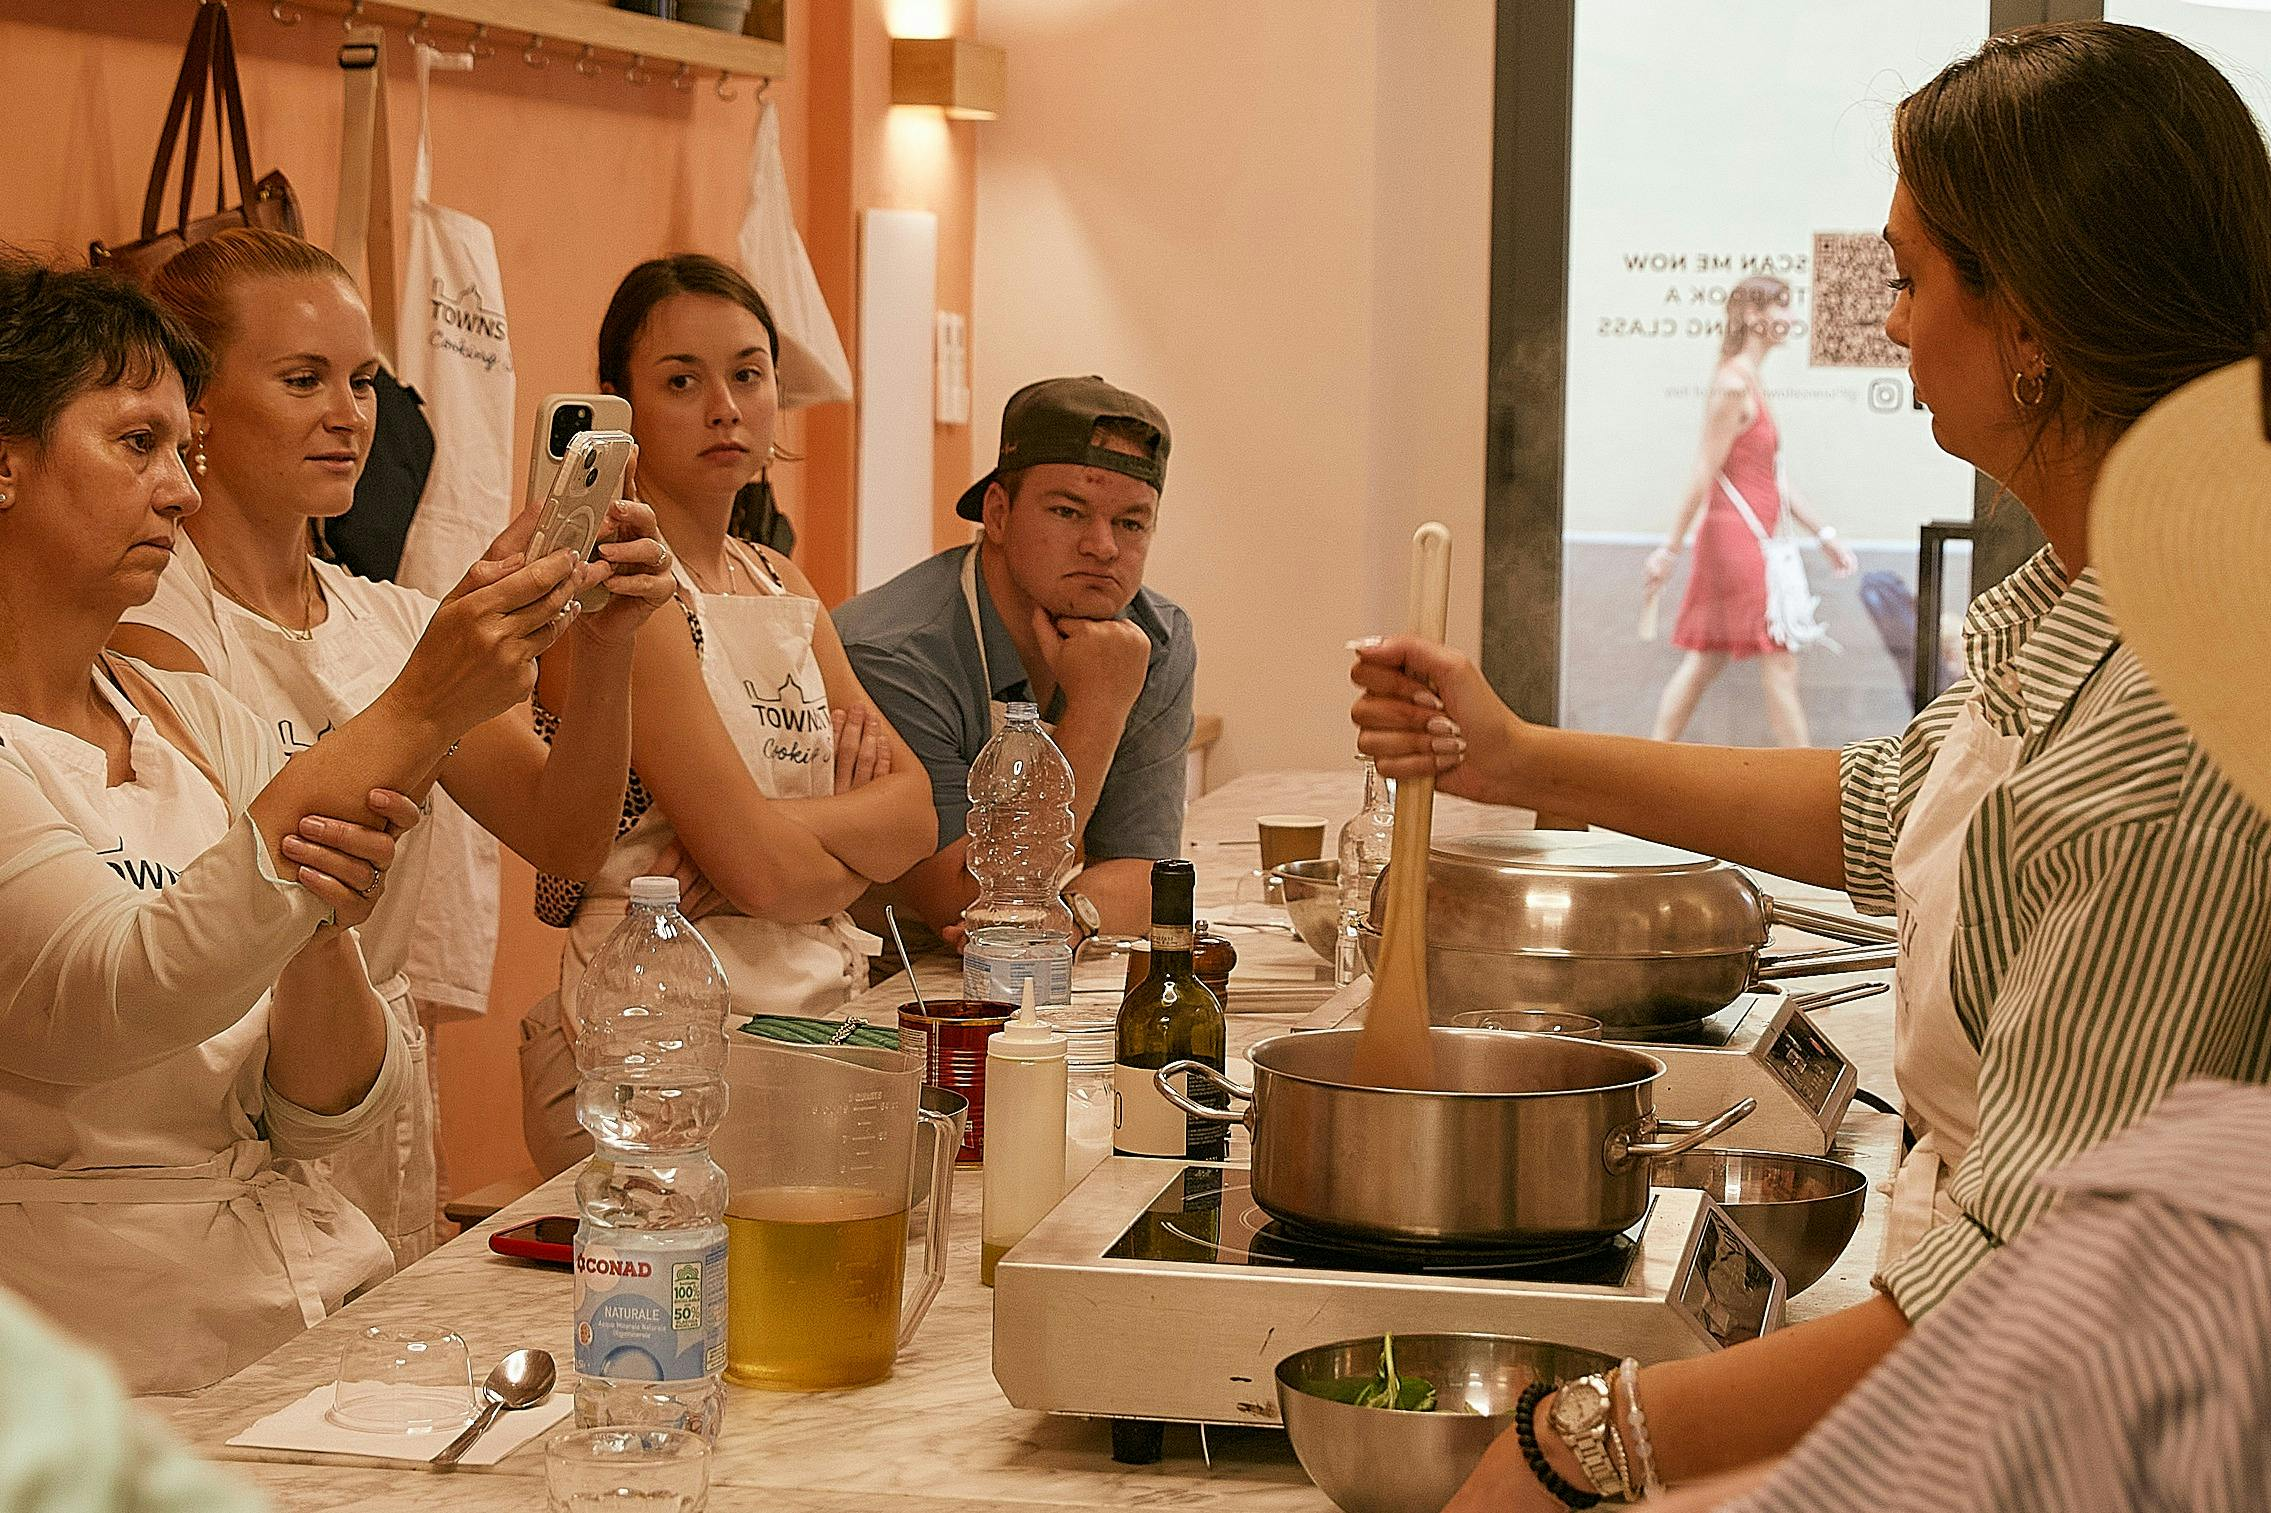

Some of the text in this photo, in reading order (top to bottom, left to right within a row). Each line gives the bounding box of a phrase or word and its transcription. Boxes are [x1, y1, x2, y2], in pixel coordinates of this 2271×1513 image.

[432, 299, 506, 342] TOWNS
[586, 1258, 652, 1278] CONAD
[674, 1284, 700, 1299] 100%
[604, 1303, 660, 1321] NATURALE
[674, 1306, 700, 1320] 50%
